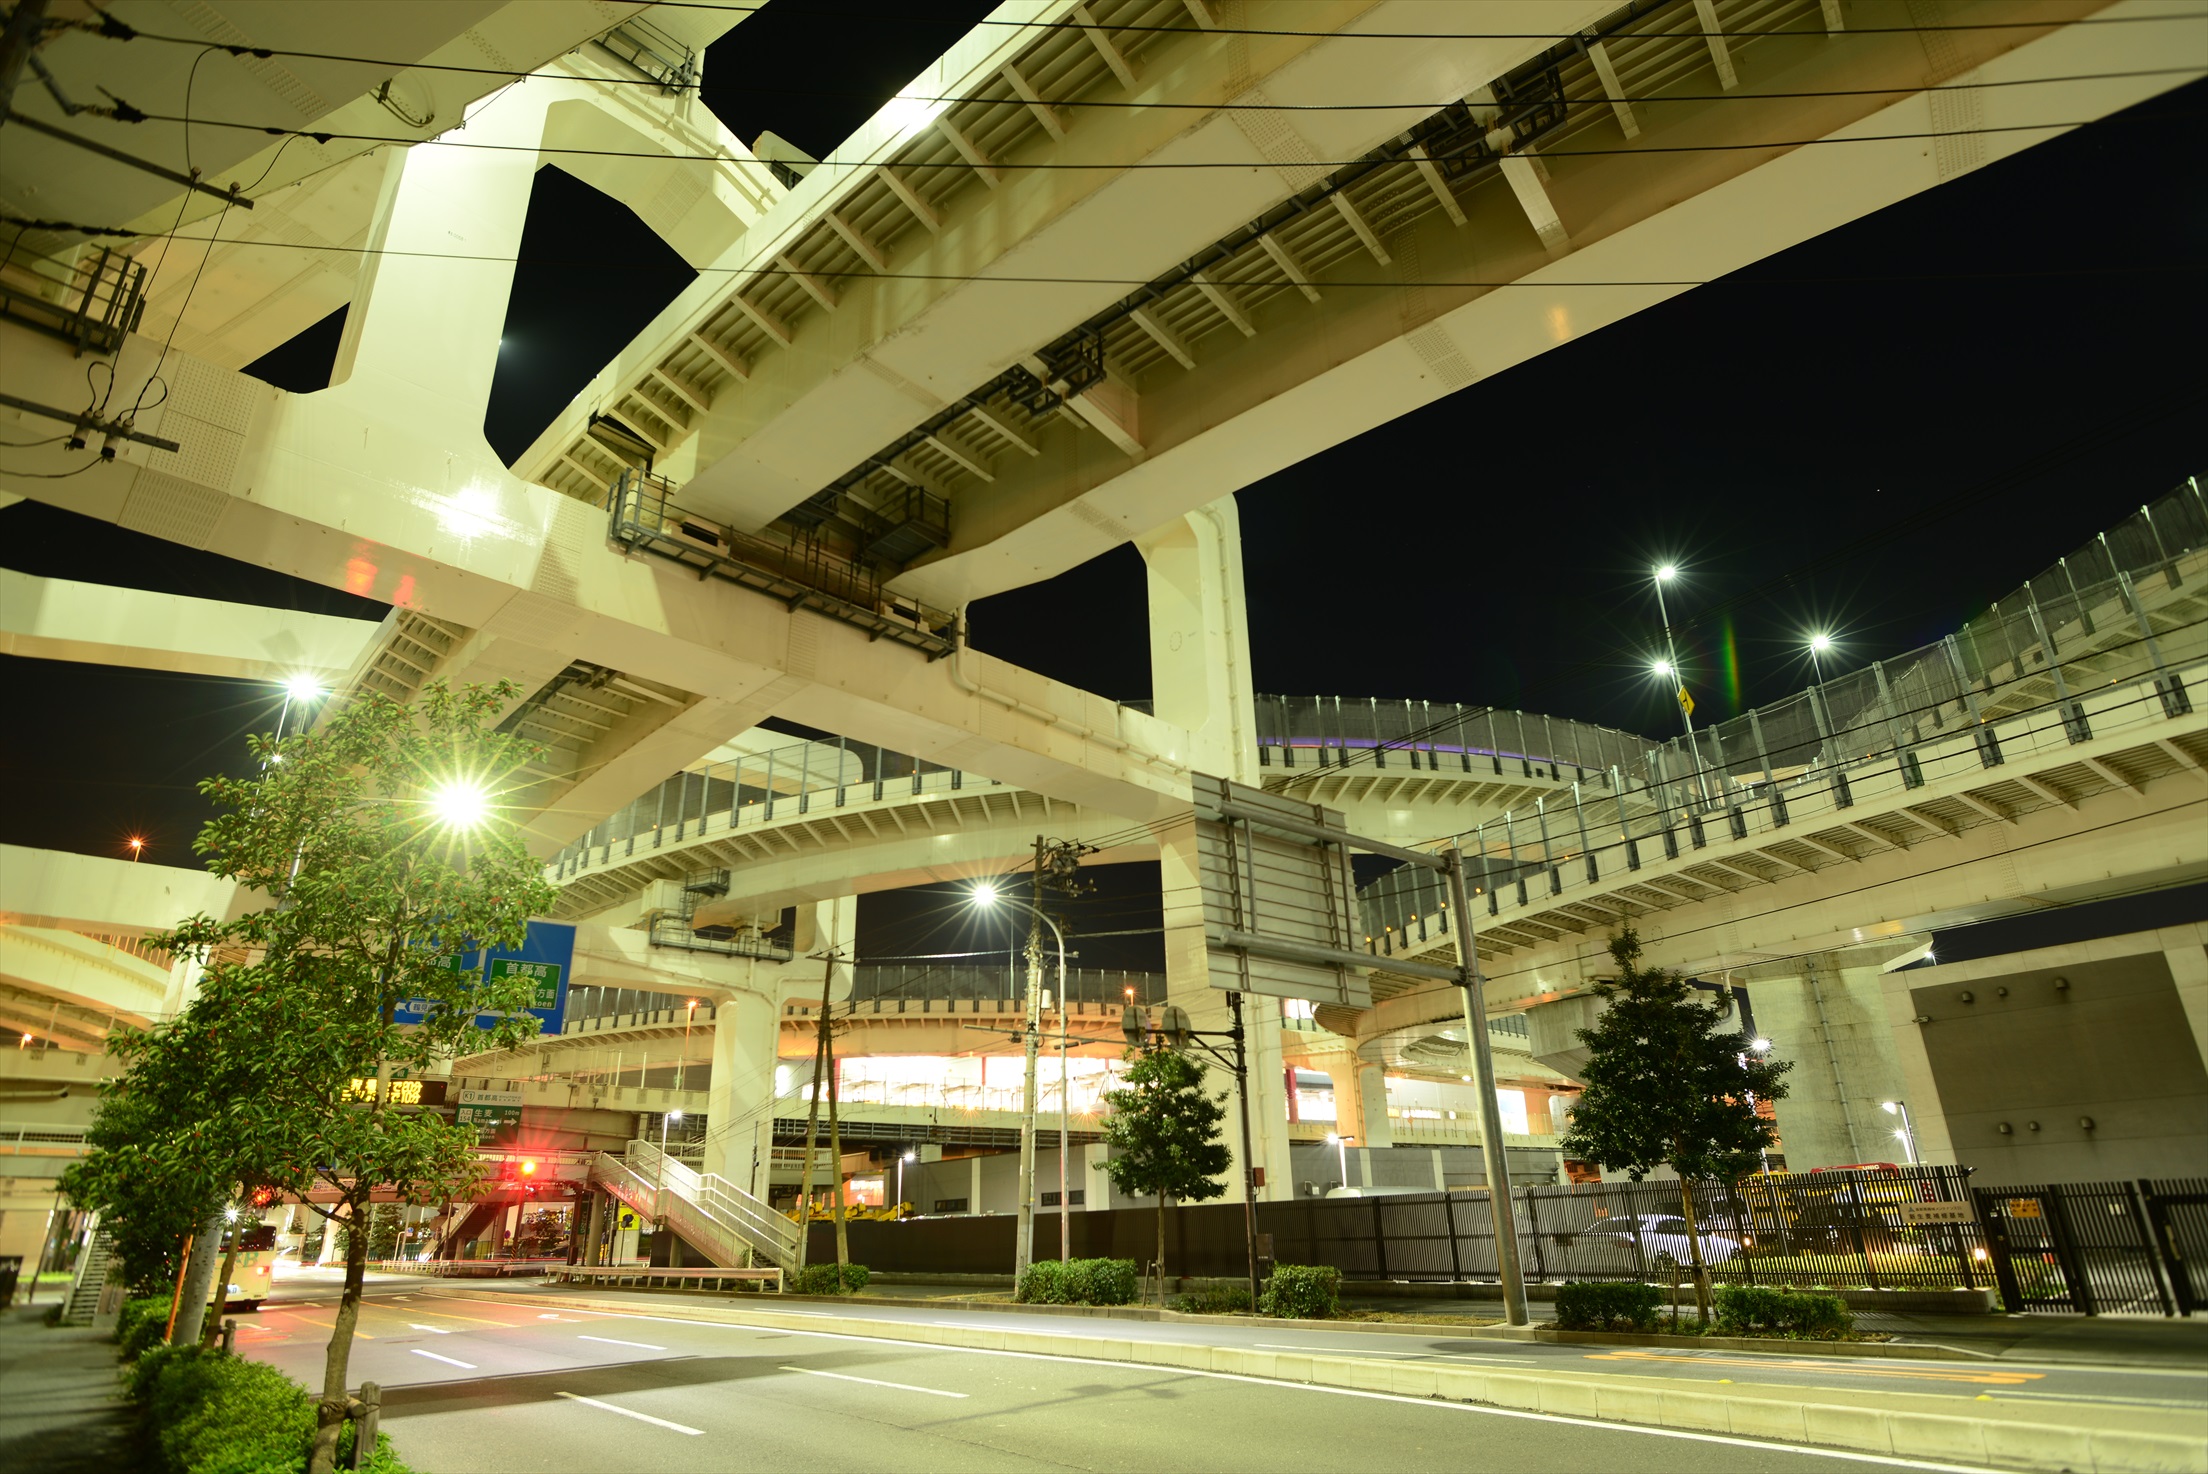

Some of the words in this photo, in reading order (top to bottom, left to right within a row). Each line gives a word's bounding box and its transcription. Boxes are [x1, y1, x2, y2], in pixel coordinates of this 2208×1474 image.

[506, 962, 548, 978] 首都高
[477, 1094, 498, 1102] 首都高
[474, 1109, 493, 1117] 生麦
